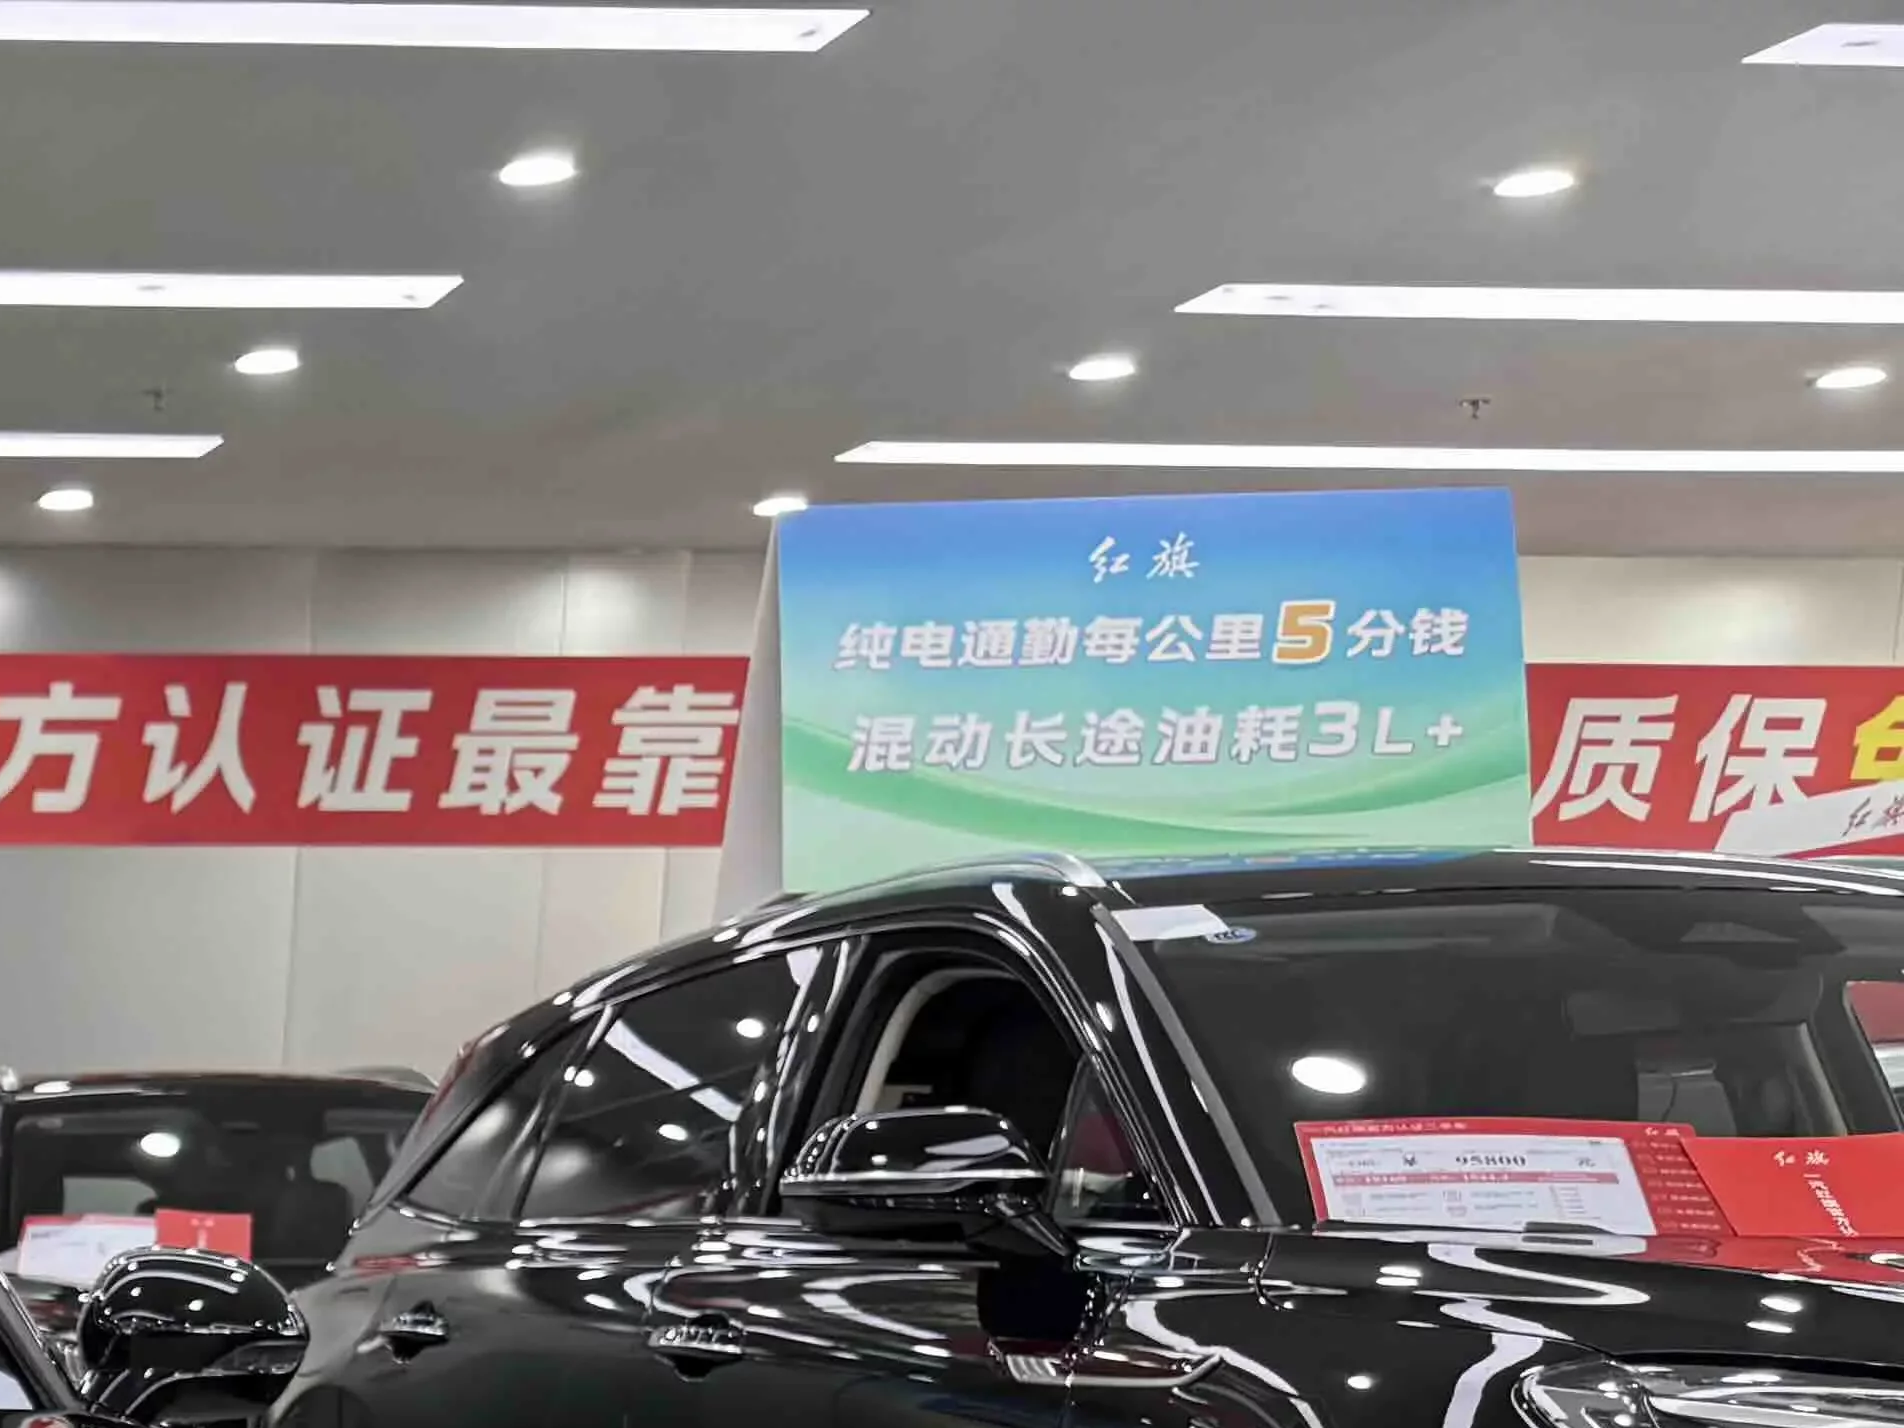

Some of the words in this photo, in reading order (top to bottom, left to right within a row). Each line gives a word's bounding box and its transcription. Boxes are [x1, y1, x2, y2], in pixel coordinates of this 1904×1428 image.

[1088, 532, 1201, 583] 红旗
[833, 599, 1470, 671] 纯电通勤每公里5分钱
[846, 699, 1465, 773] 混动长途油耗3L+
